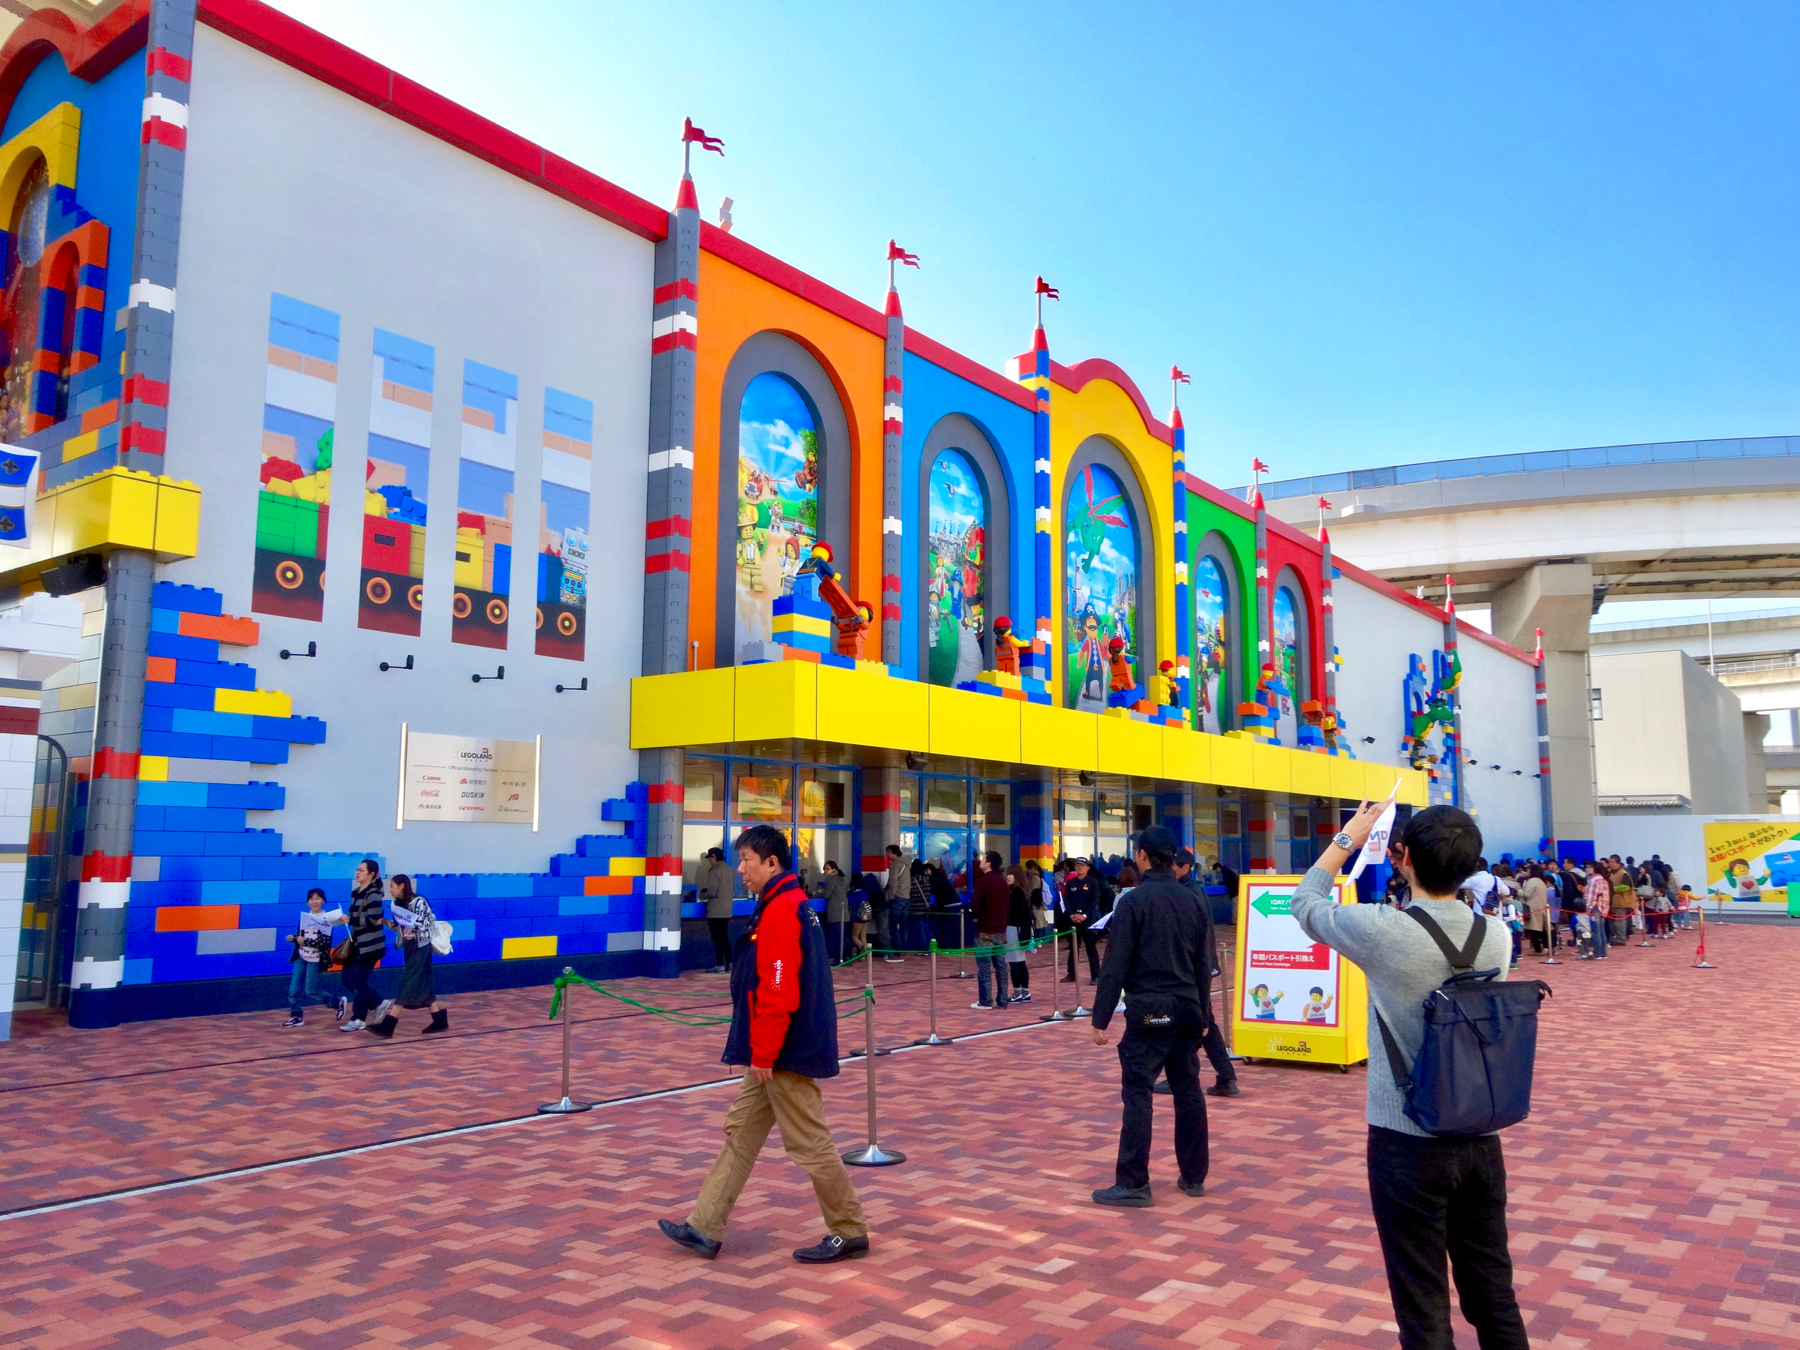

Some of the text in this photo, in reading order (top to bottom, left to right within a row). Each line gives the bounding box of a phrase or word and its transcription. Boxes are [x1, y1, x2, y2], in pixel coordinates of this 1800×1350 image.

[461, 749, 493, 760] LEGOLAND
[461, 791, 486, 799] DUSKIN
[1252, 953, 1315, 963] 年間パスポート引換え
[1276, 1043, 1312, 1053] LEGOLAND
